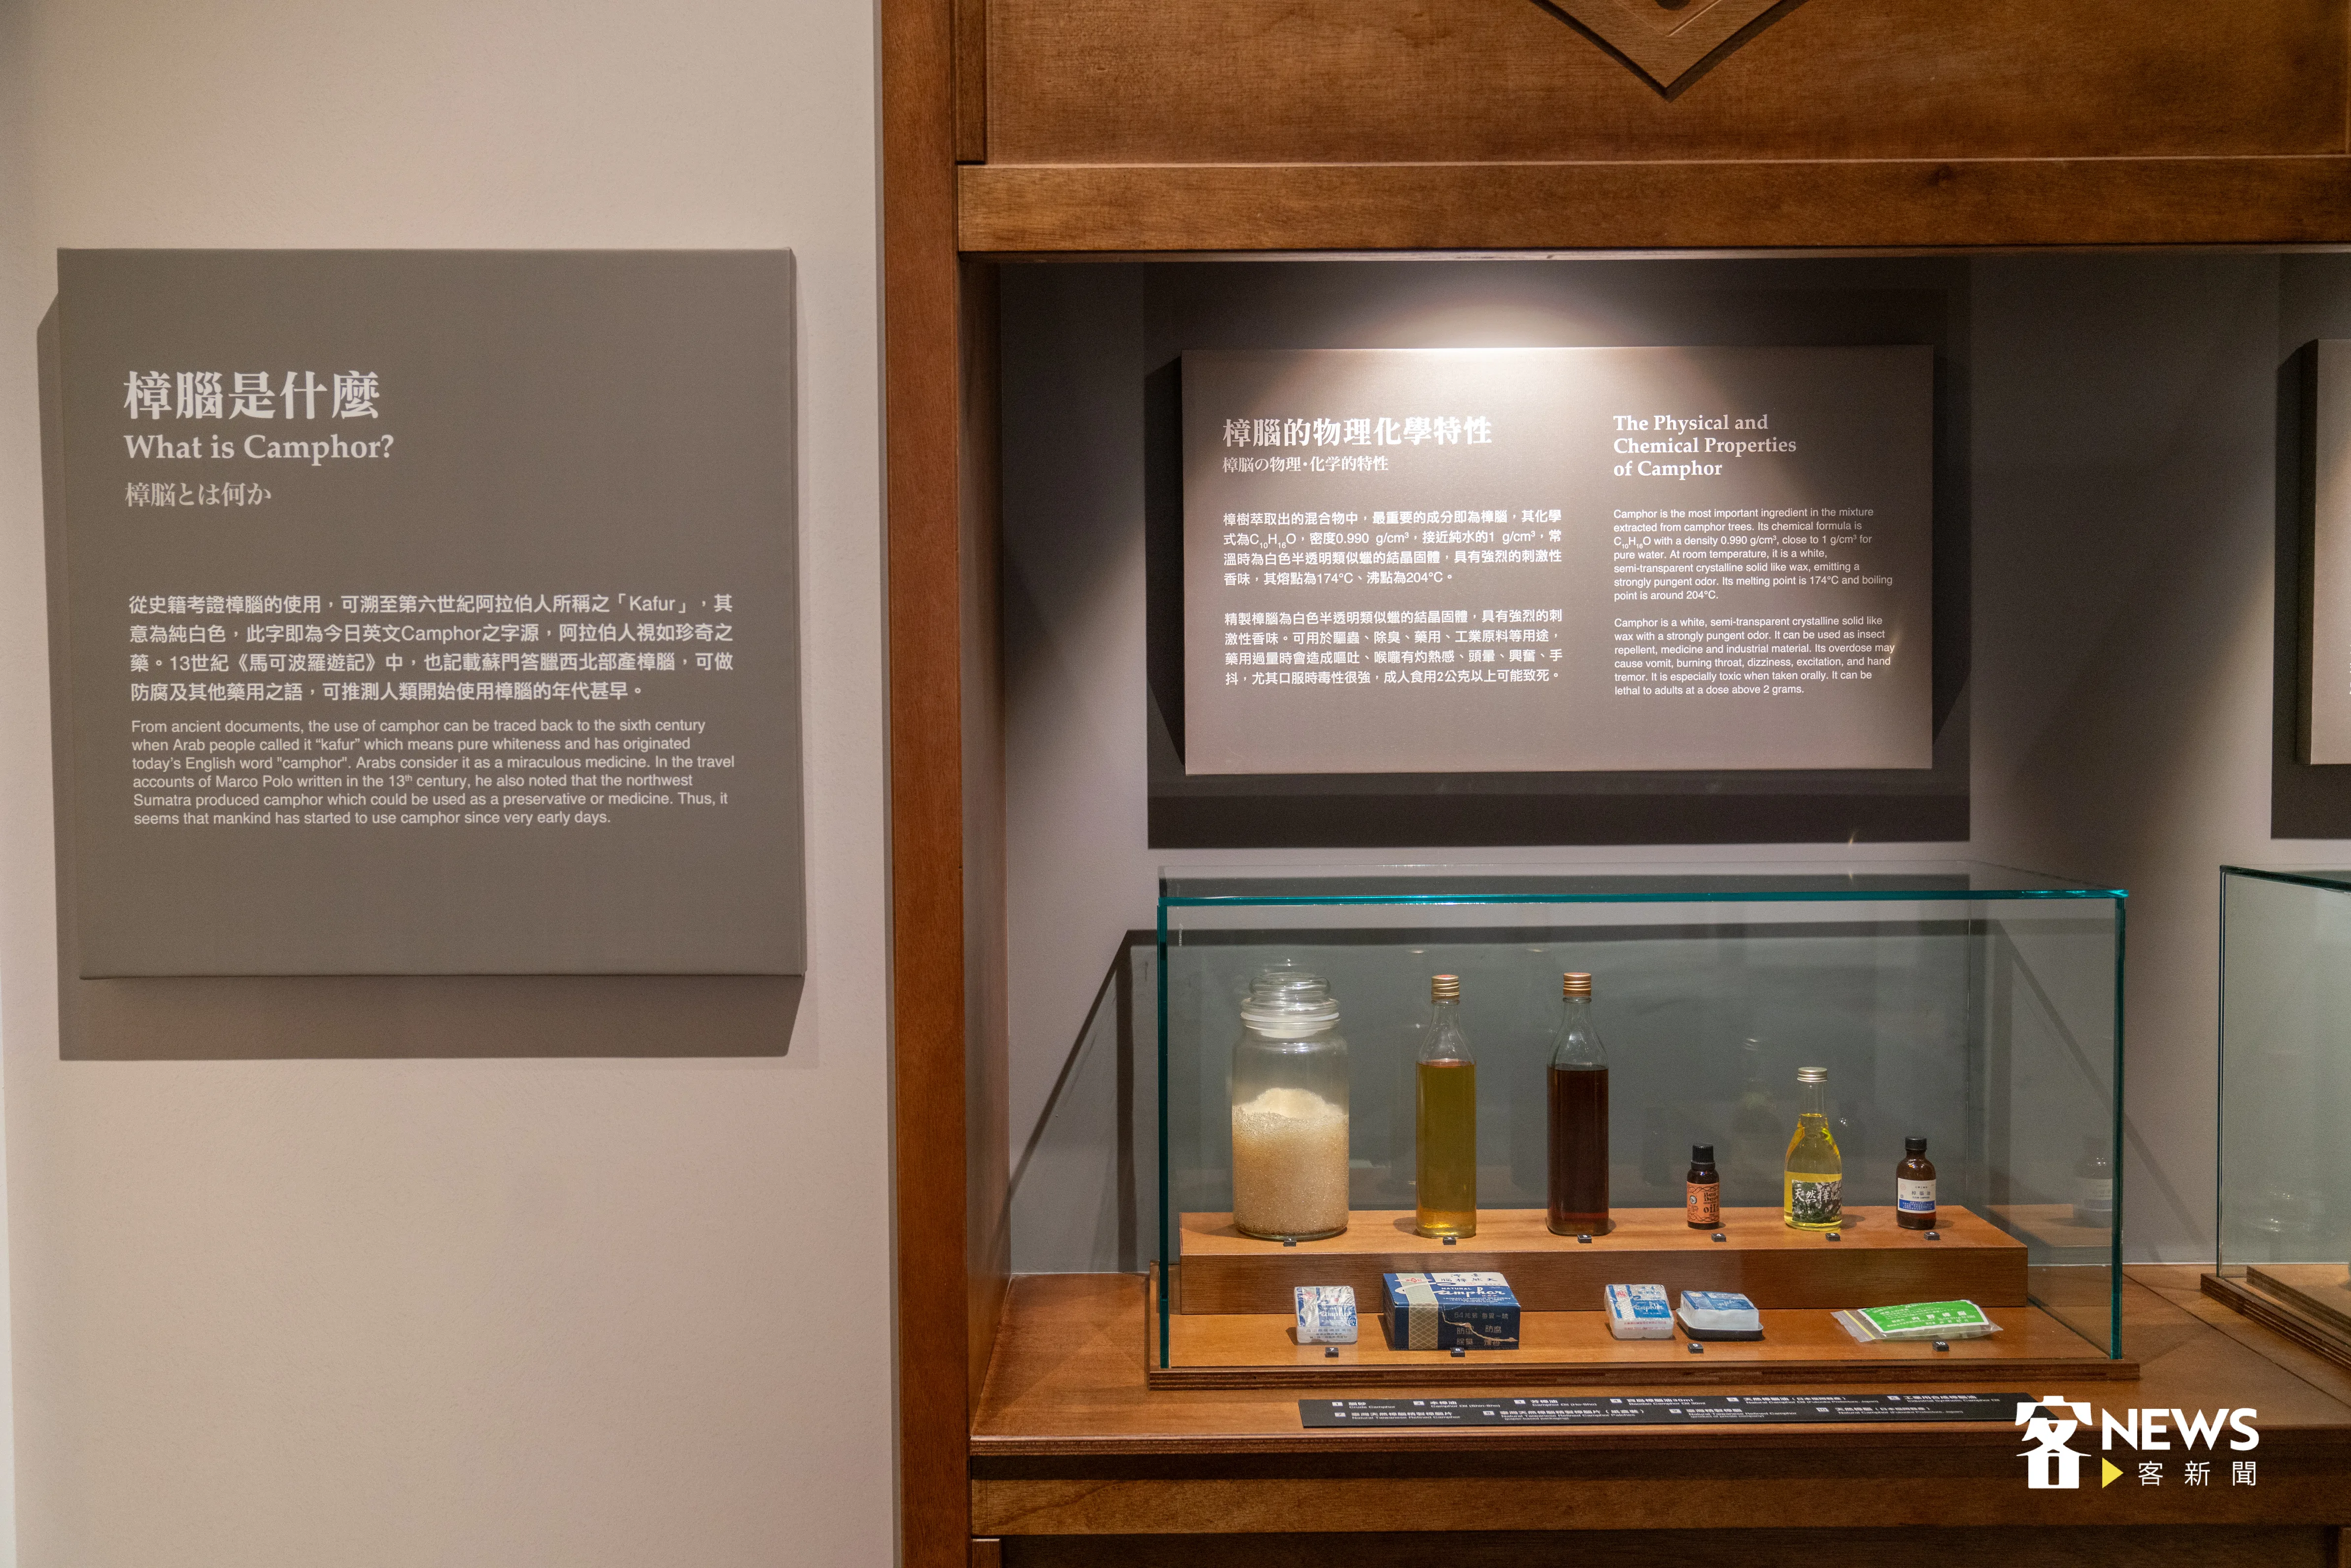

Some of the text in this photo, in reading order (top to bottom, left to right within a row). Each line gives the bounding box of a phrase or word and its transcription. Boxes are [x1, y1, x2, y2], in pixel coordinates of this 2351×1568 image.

[124, 371, 379, 419] 樟腦是什麼
[1223, 415, 1493, 447] 樟腦的物理化學特性
[1614, 414, 1768, 435] The Physical and
[124, 434, 393, 466] What is Camphor?
[1614, 437, 1796, 457] Chemical Properties
[1614, 460, 1722, 480] of Camphor
[126, 482, 271, 507] 樟脳とは何か
[1613, 508, 1874, 520] Camphor is the most important ingredient in the mixture
[1614, 564, 1694, 575] semi-transparent
[1696, 563, 1743, 574] crystalline
[1746, 562, 1768, 572] solid
[1771, 562, 1786, 571] like
[1814, 562, 1851, 573] emitting
[1615, 646, 1657, 656] repellent,
[1661, 645, 1703, 653] medicine
[1727, 645, 1768, 653] industrial
[1772, 644, 1811, 652] material.
[1829, 644, 1872, 652] overdose
[1875, 644, 1896, 654] may
[1615, 686, 1640, 695] lethal
[1655, 686, 1683, 694] adults
[1732, 685, 1760, 694] above
[1764, 685, 1769, 693] 2
[1772, 686, 1804, 695] grams.
[132, 719, 705, 734] From ancient documents, the use of camphor can be traced back to the sixth century
[134, 792, 727, 809] Sumatra produced camphor which could be used as a preservative or medicine. Thus, it
[1704, 1204, 1716, 1213] oil
